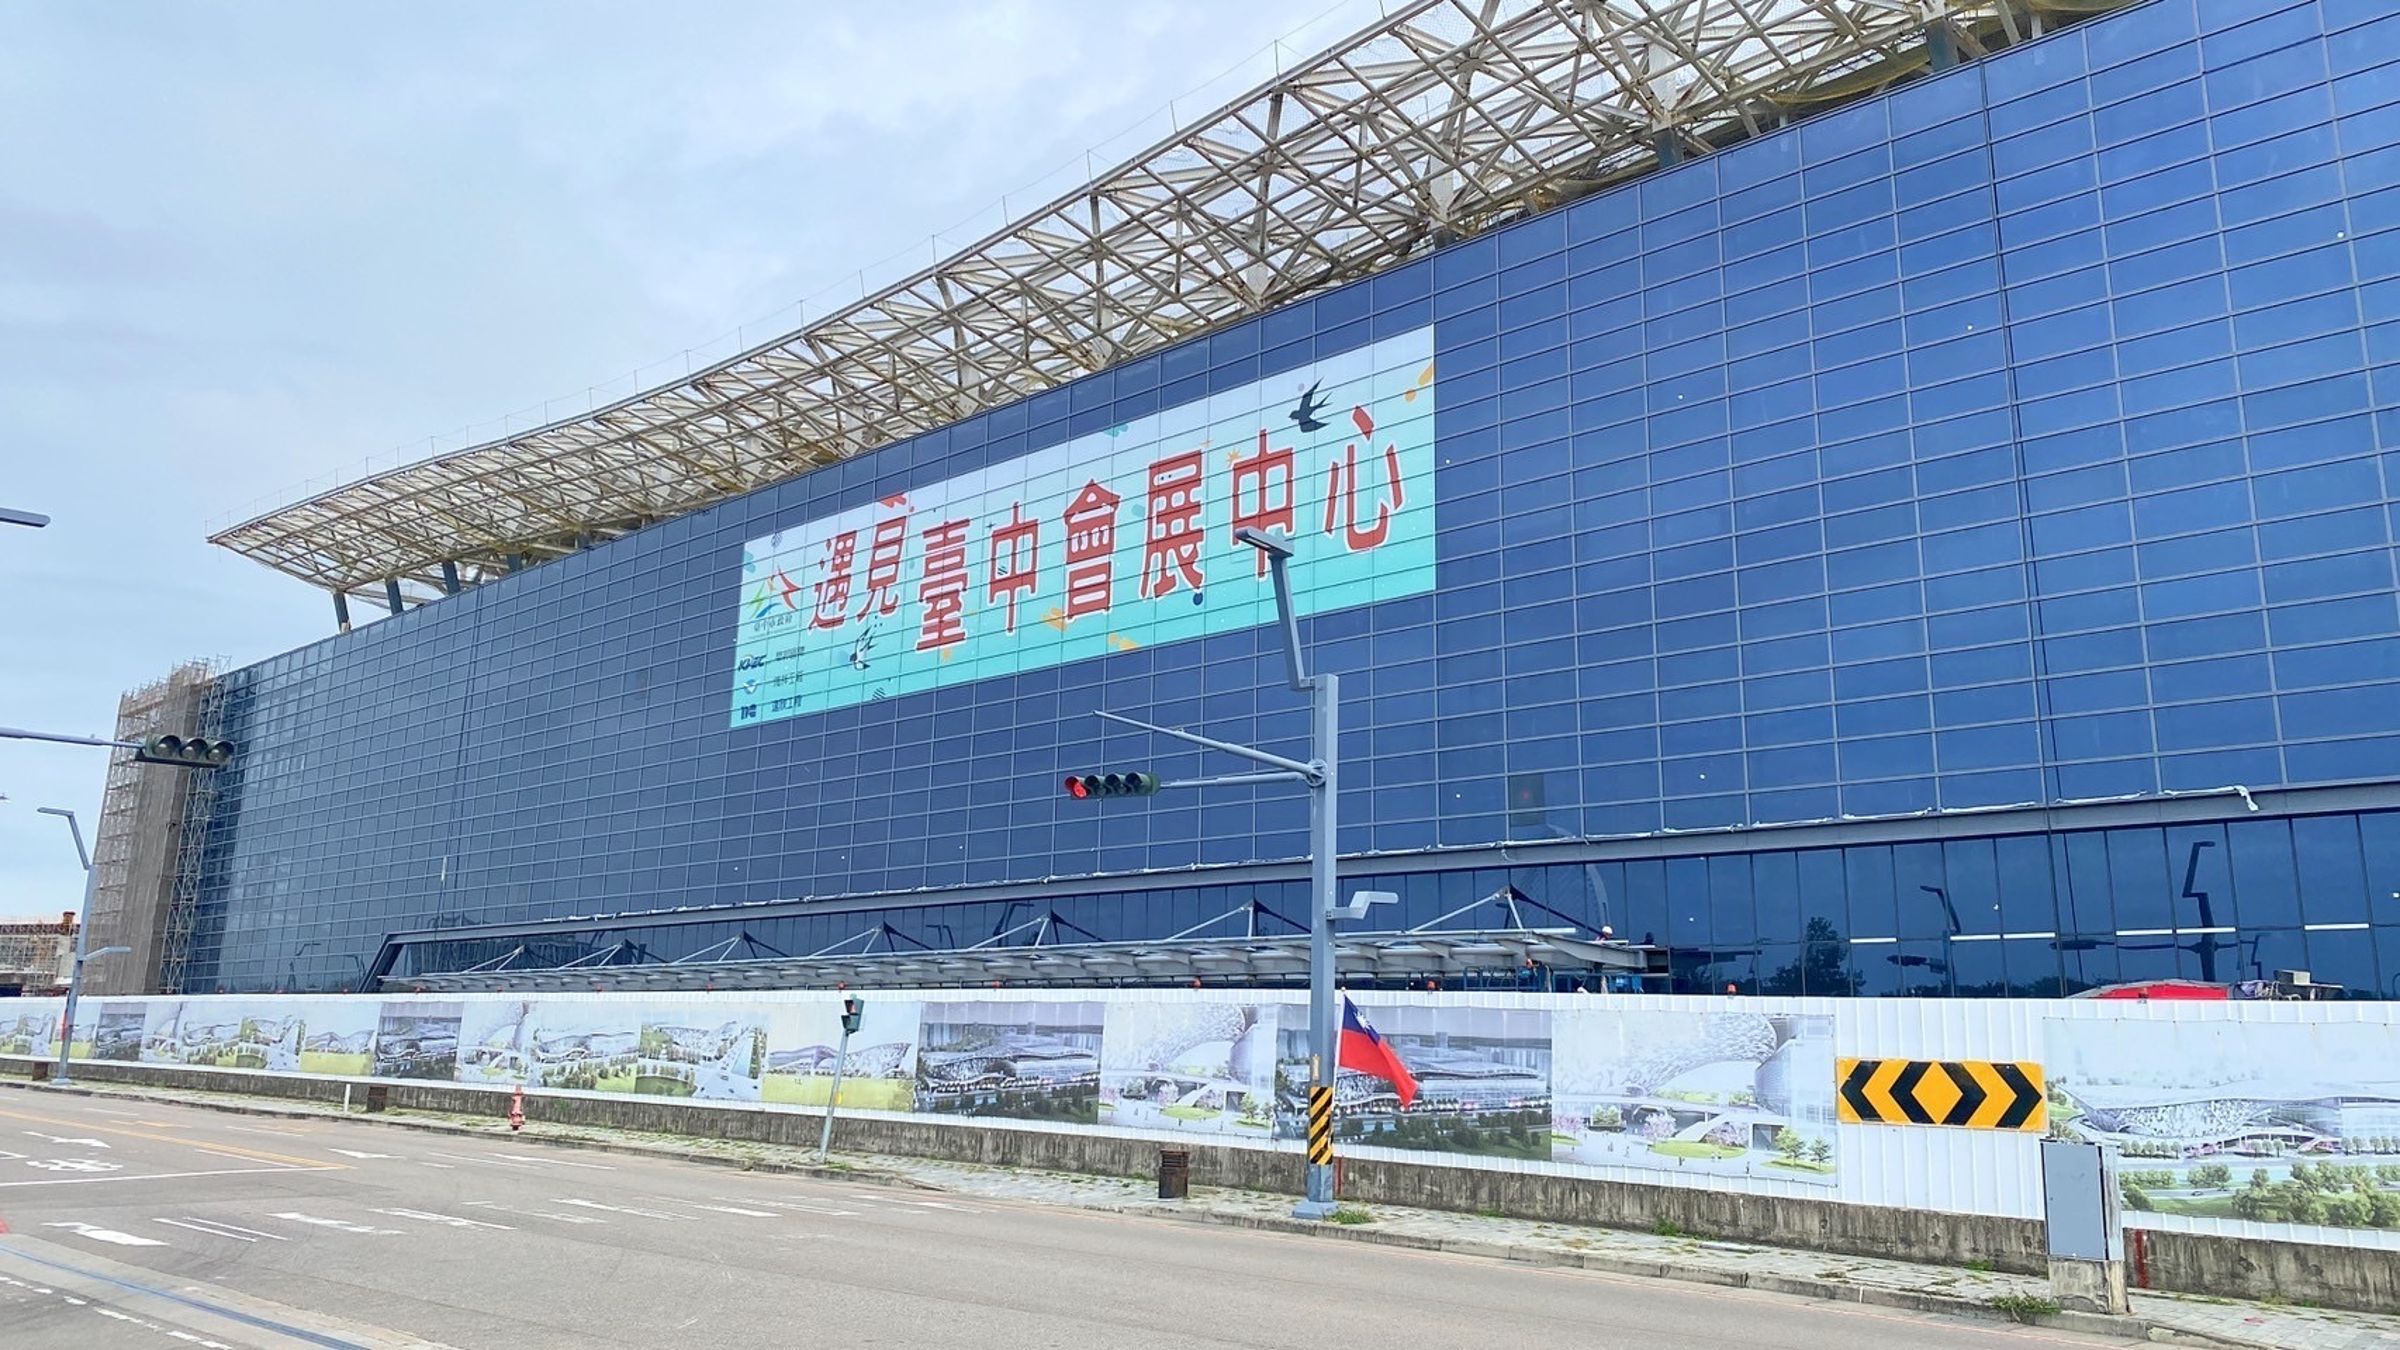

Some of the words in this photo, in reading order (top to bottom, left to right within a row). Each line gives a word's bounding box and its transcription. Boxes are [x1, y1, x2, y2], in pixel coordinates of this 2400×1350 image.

[806, 404, 1405, 653] 遇見臺中會展中心
